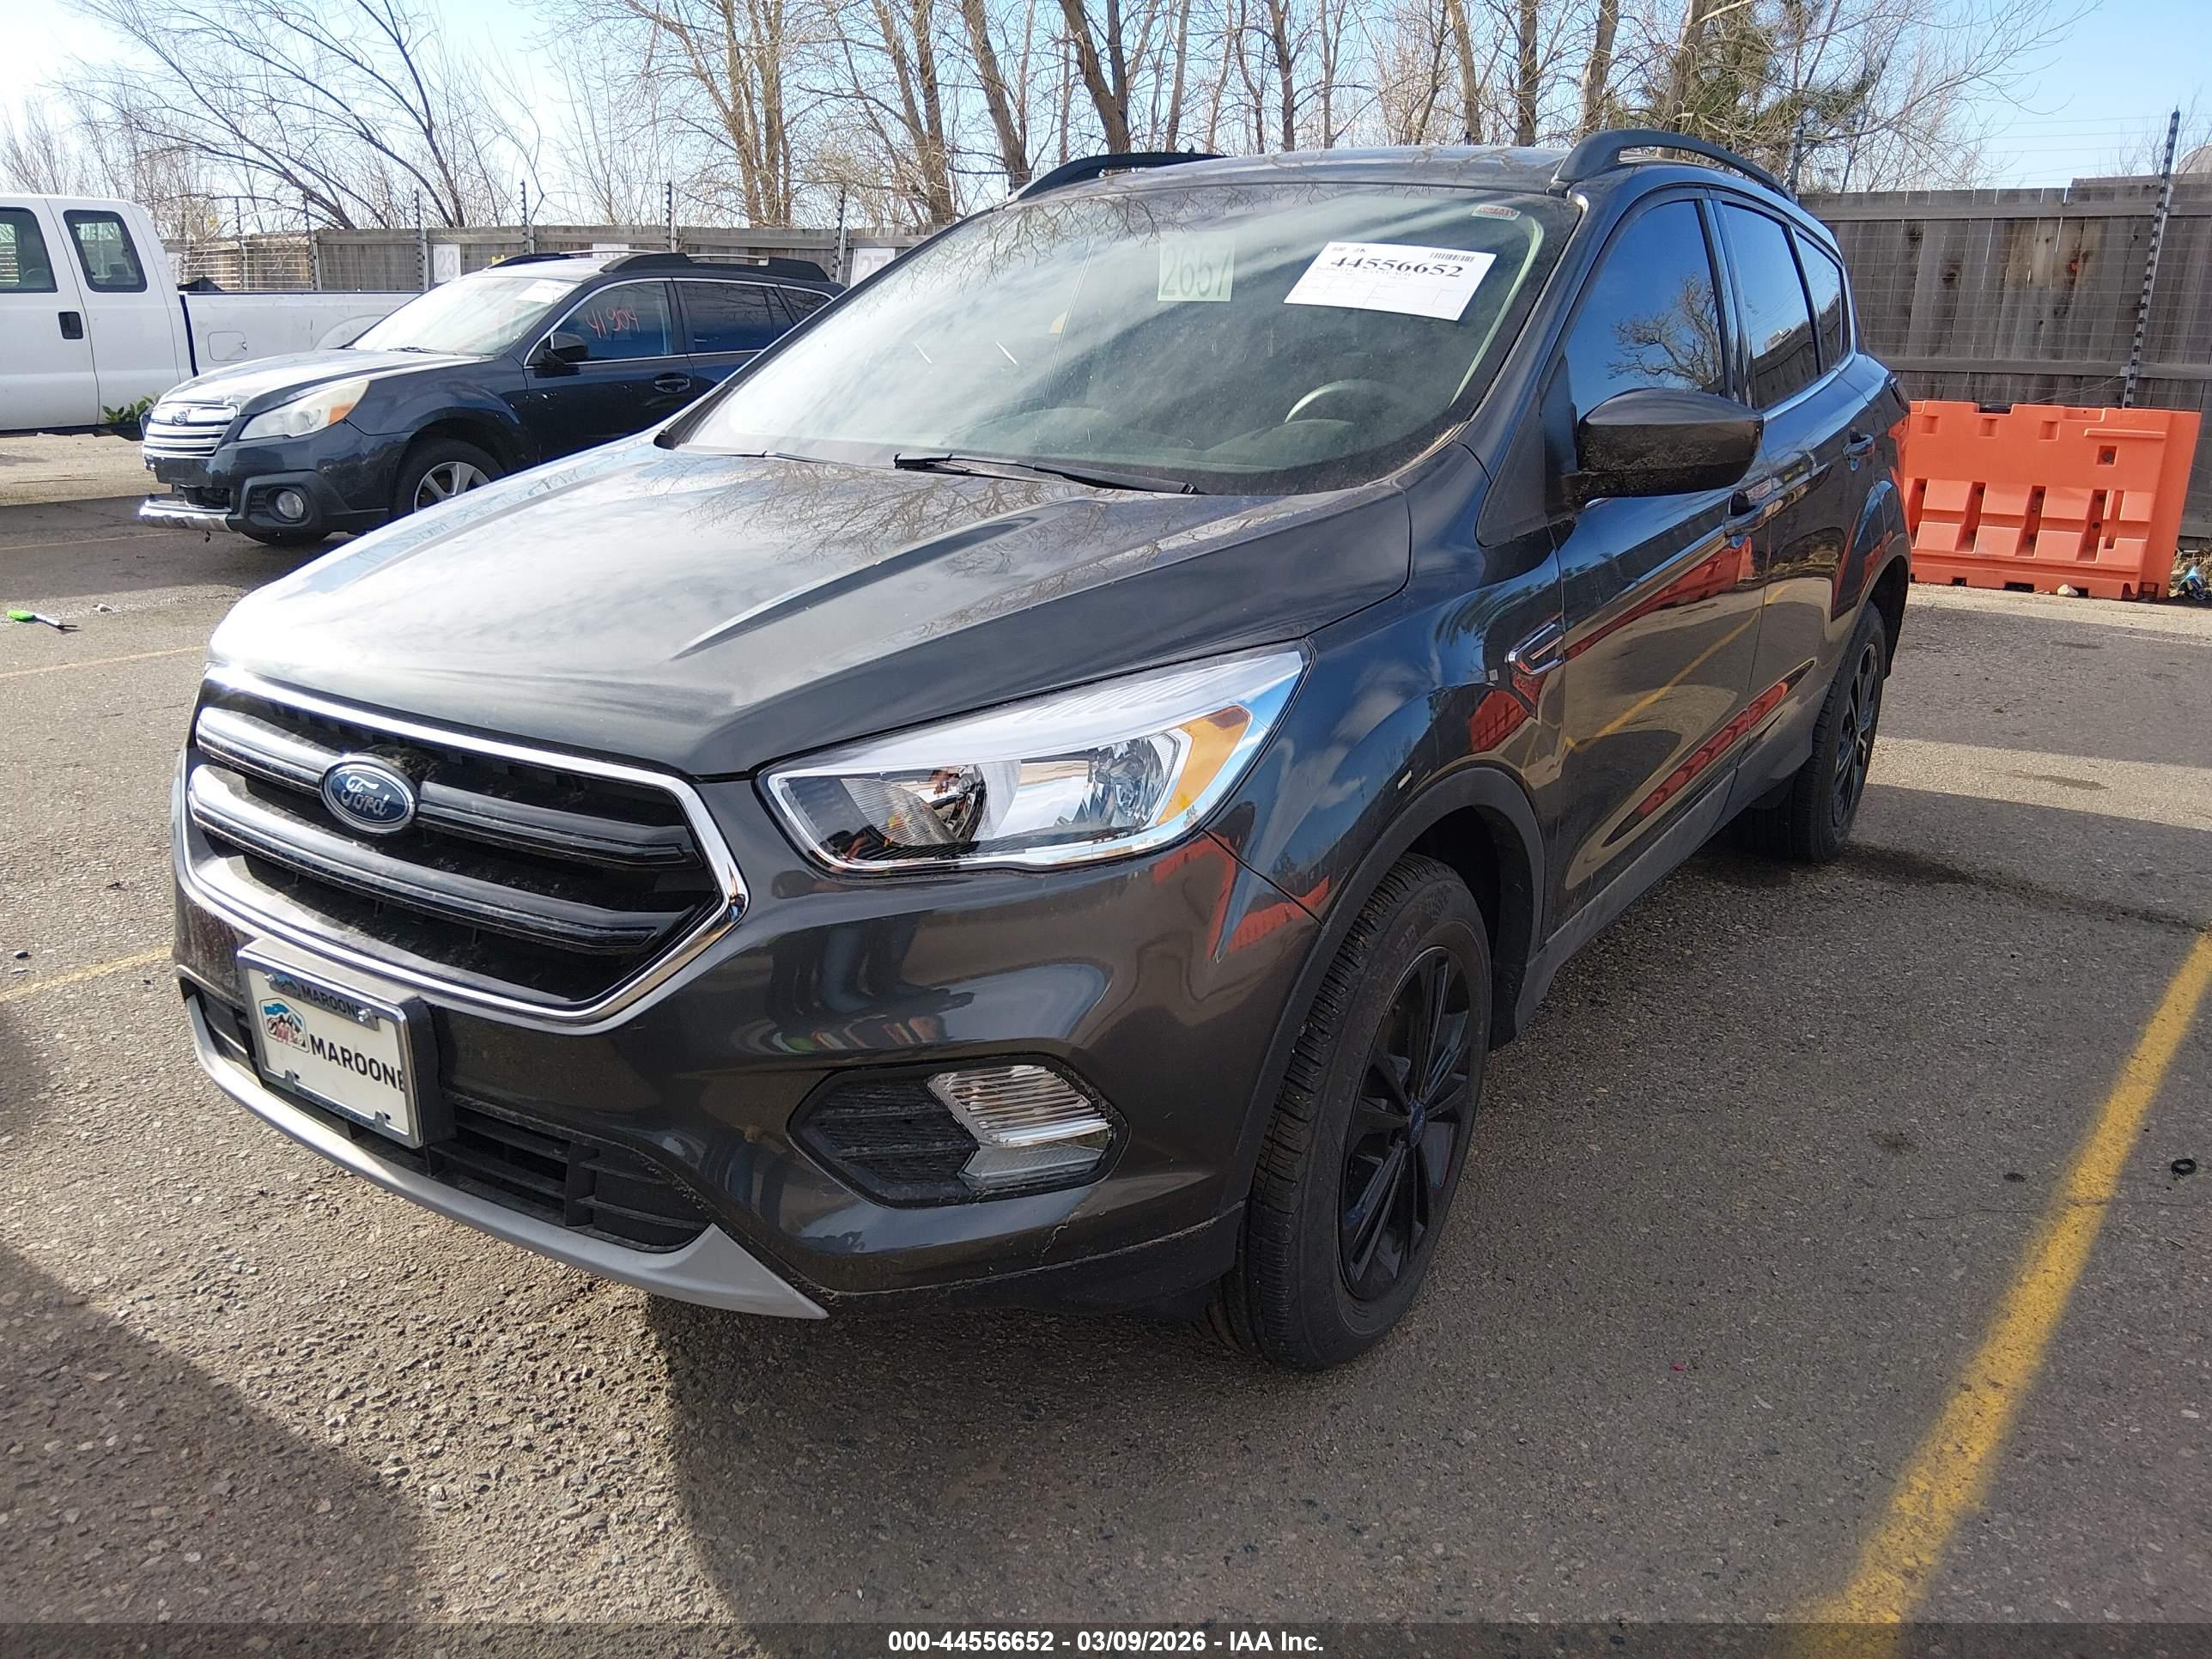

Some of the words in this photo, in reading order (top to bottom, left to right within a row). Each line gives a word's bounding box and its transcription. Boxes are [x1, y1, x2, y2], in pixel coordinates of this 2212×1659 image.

[437, 250, 457, 276] 23
[1329, 257, 1464, 278] 44556652
[340, 775, 391, 817] Ford
[309, 1033, 405, 1092] MAROONE
